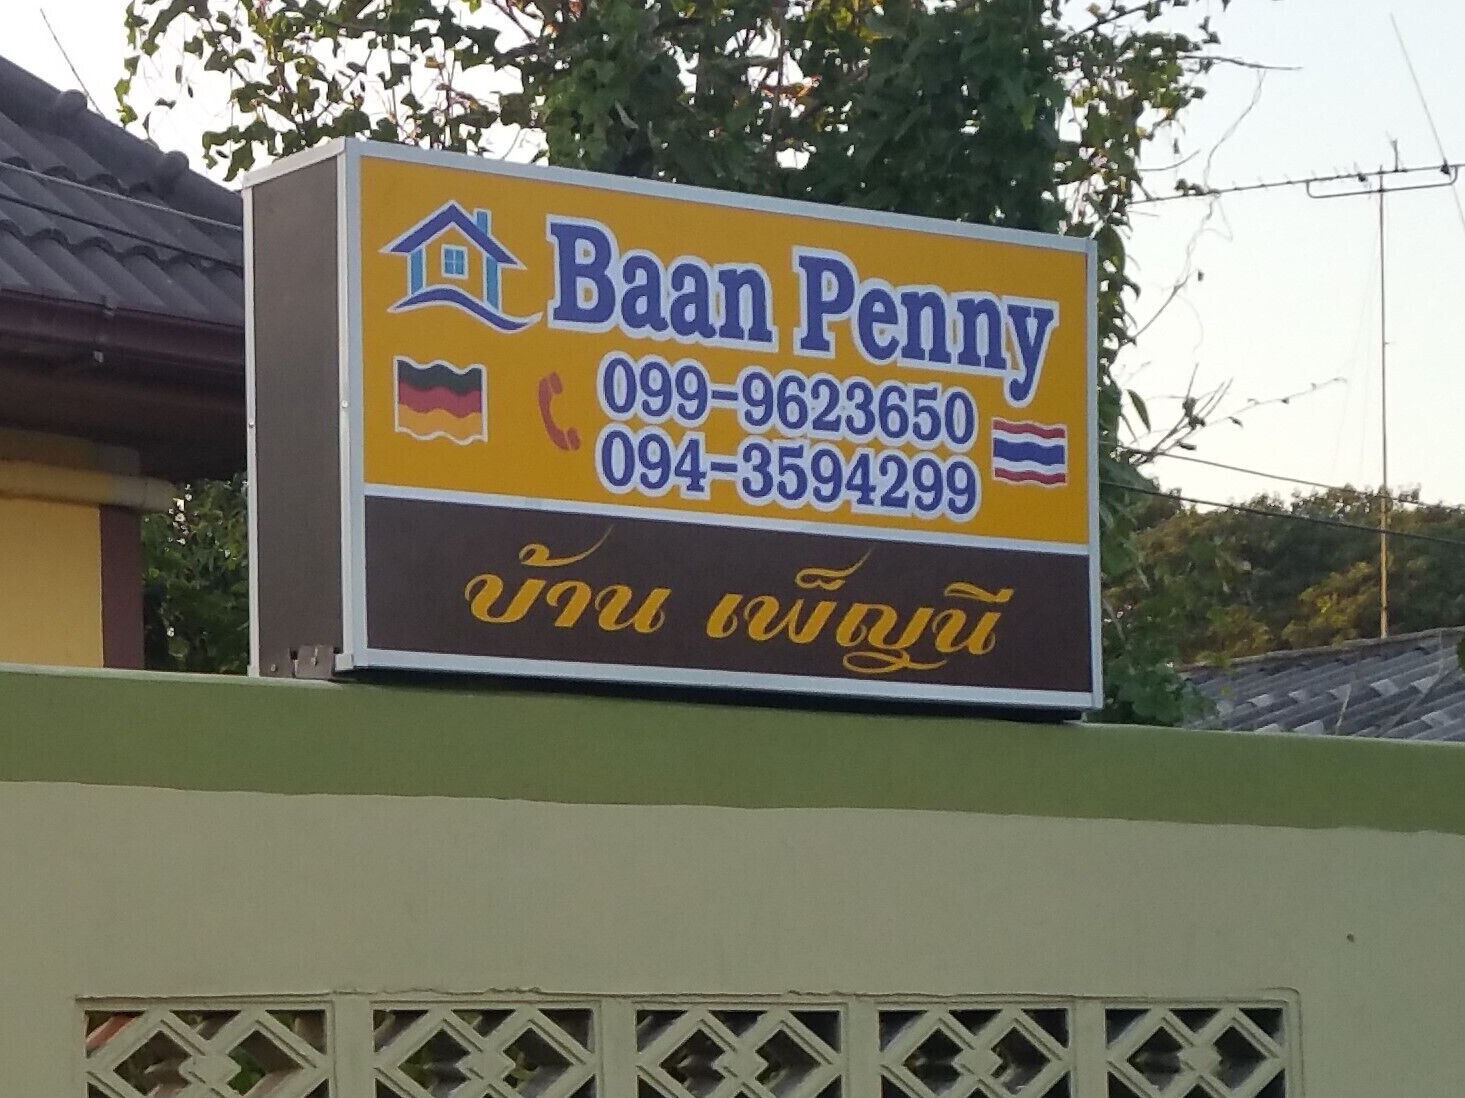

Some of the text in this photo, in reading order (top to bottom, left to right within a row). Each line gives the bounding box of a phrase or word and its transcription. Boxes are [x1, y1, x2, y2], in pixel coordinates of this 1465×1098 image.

[550, 222, 1055, 401] Baan Penny
[602, 357, 975, 447] 099-9623650
[601, 429, 977, 515] 094-3594299
[464, 525, 1014, 674] บ้าน เพ็ญนี
